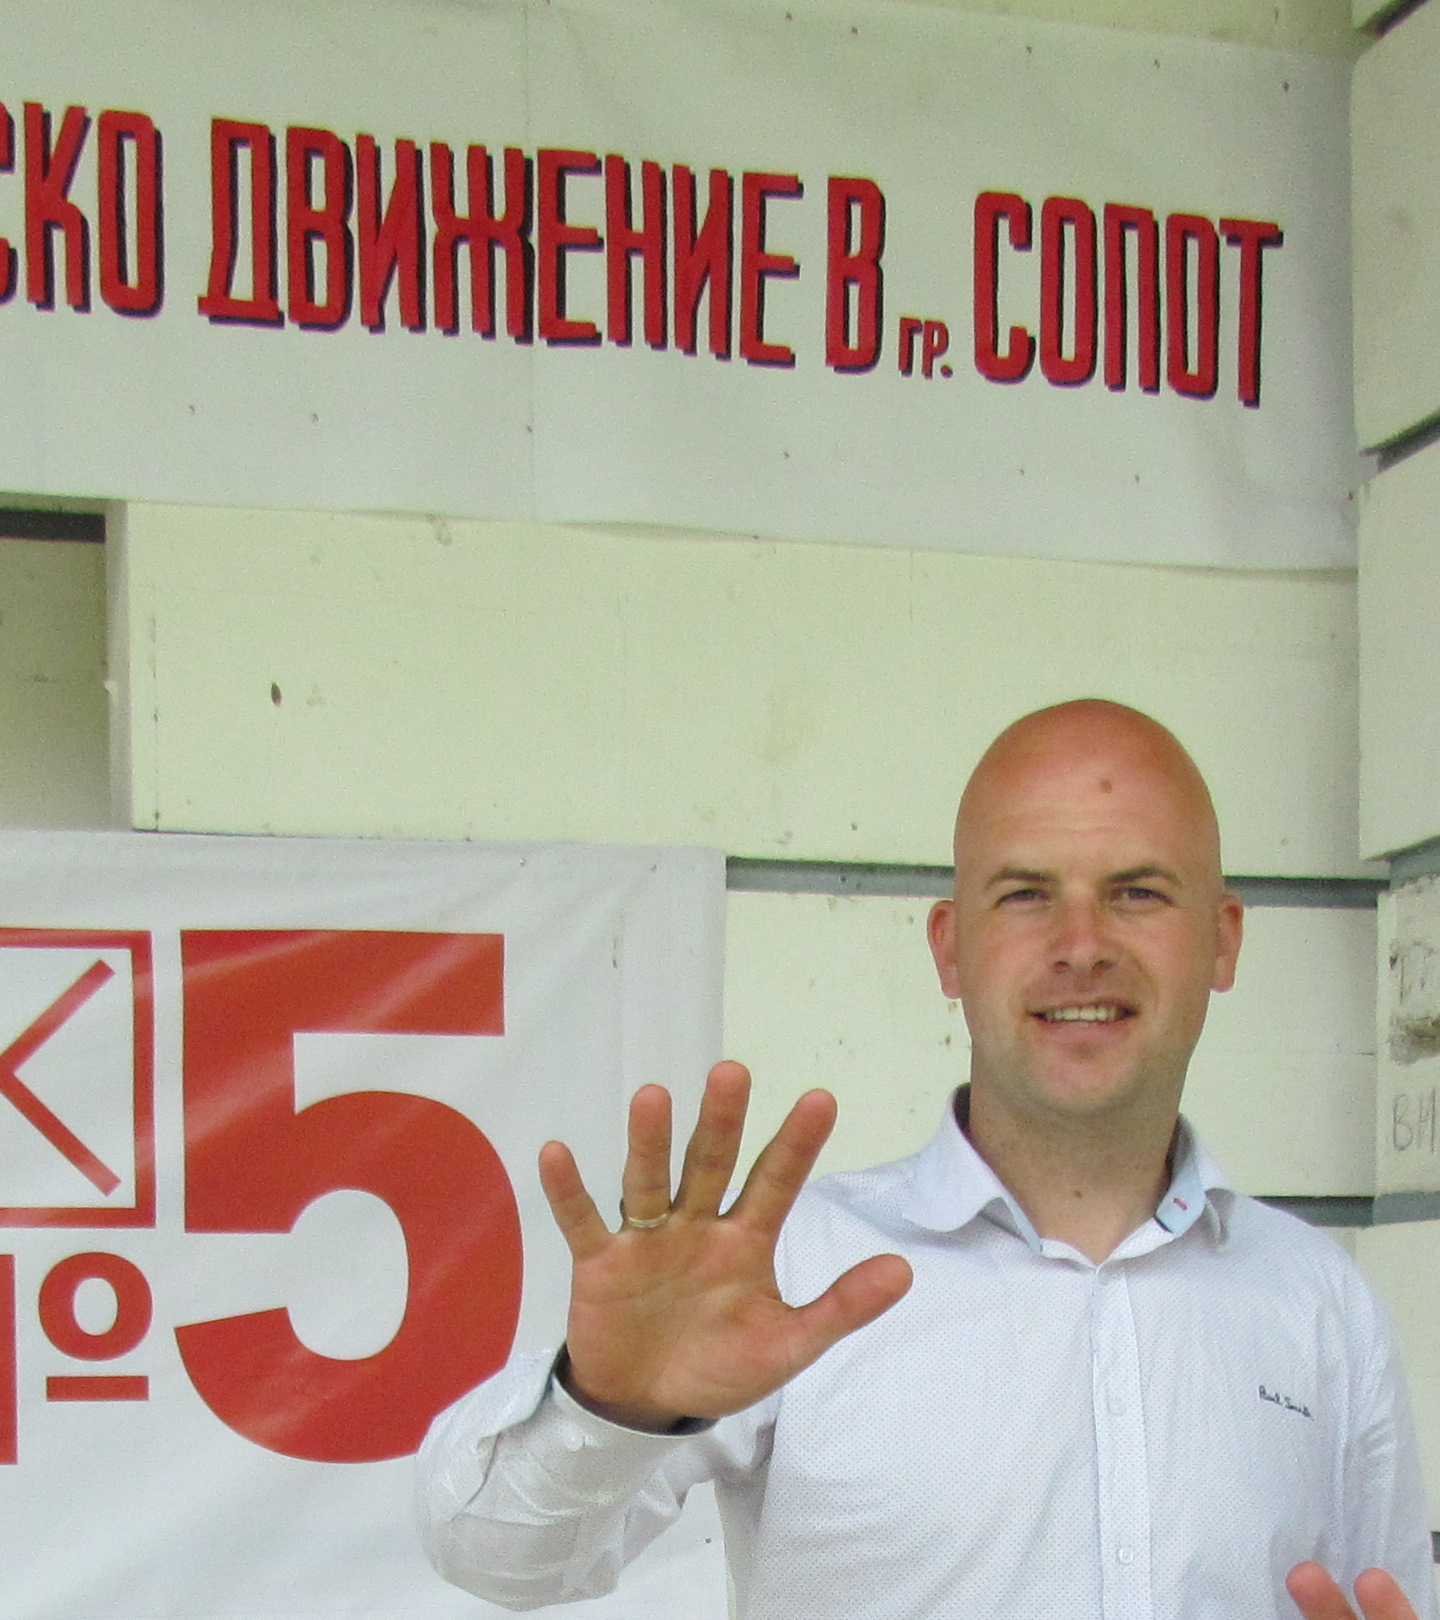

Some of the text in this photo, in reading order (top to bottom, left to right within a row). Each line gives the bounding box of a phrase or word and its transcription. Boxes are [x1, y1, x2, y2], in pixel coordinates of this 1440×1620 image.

[198, 118, 803, 368] ДВИЖЕНИЕ
[825, 176, 887, 374] В
[973, 191, 1284, 409] СОПОТ
[173, 929, 524, 1464] 5
